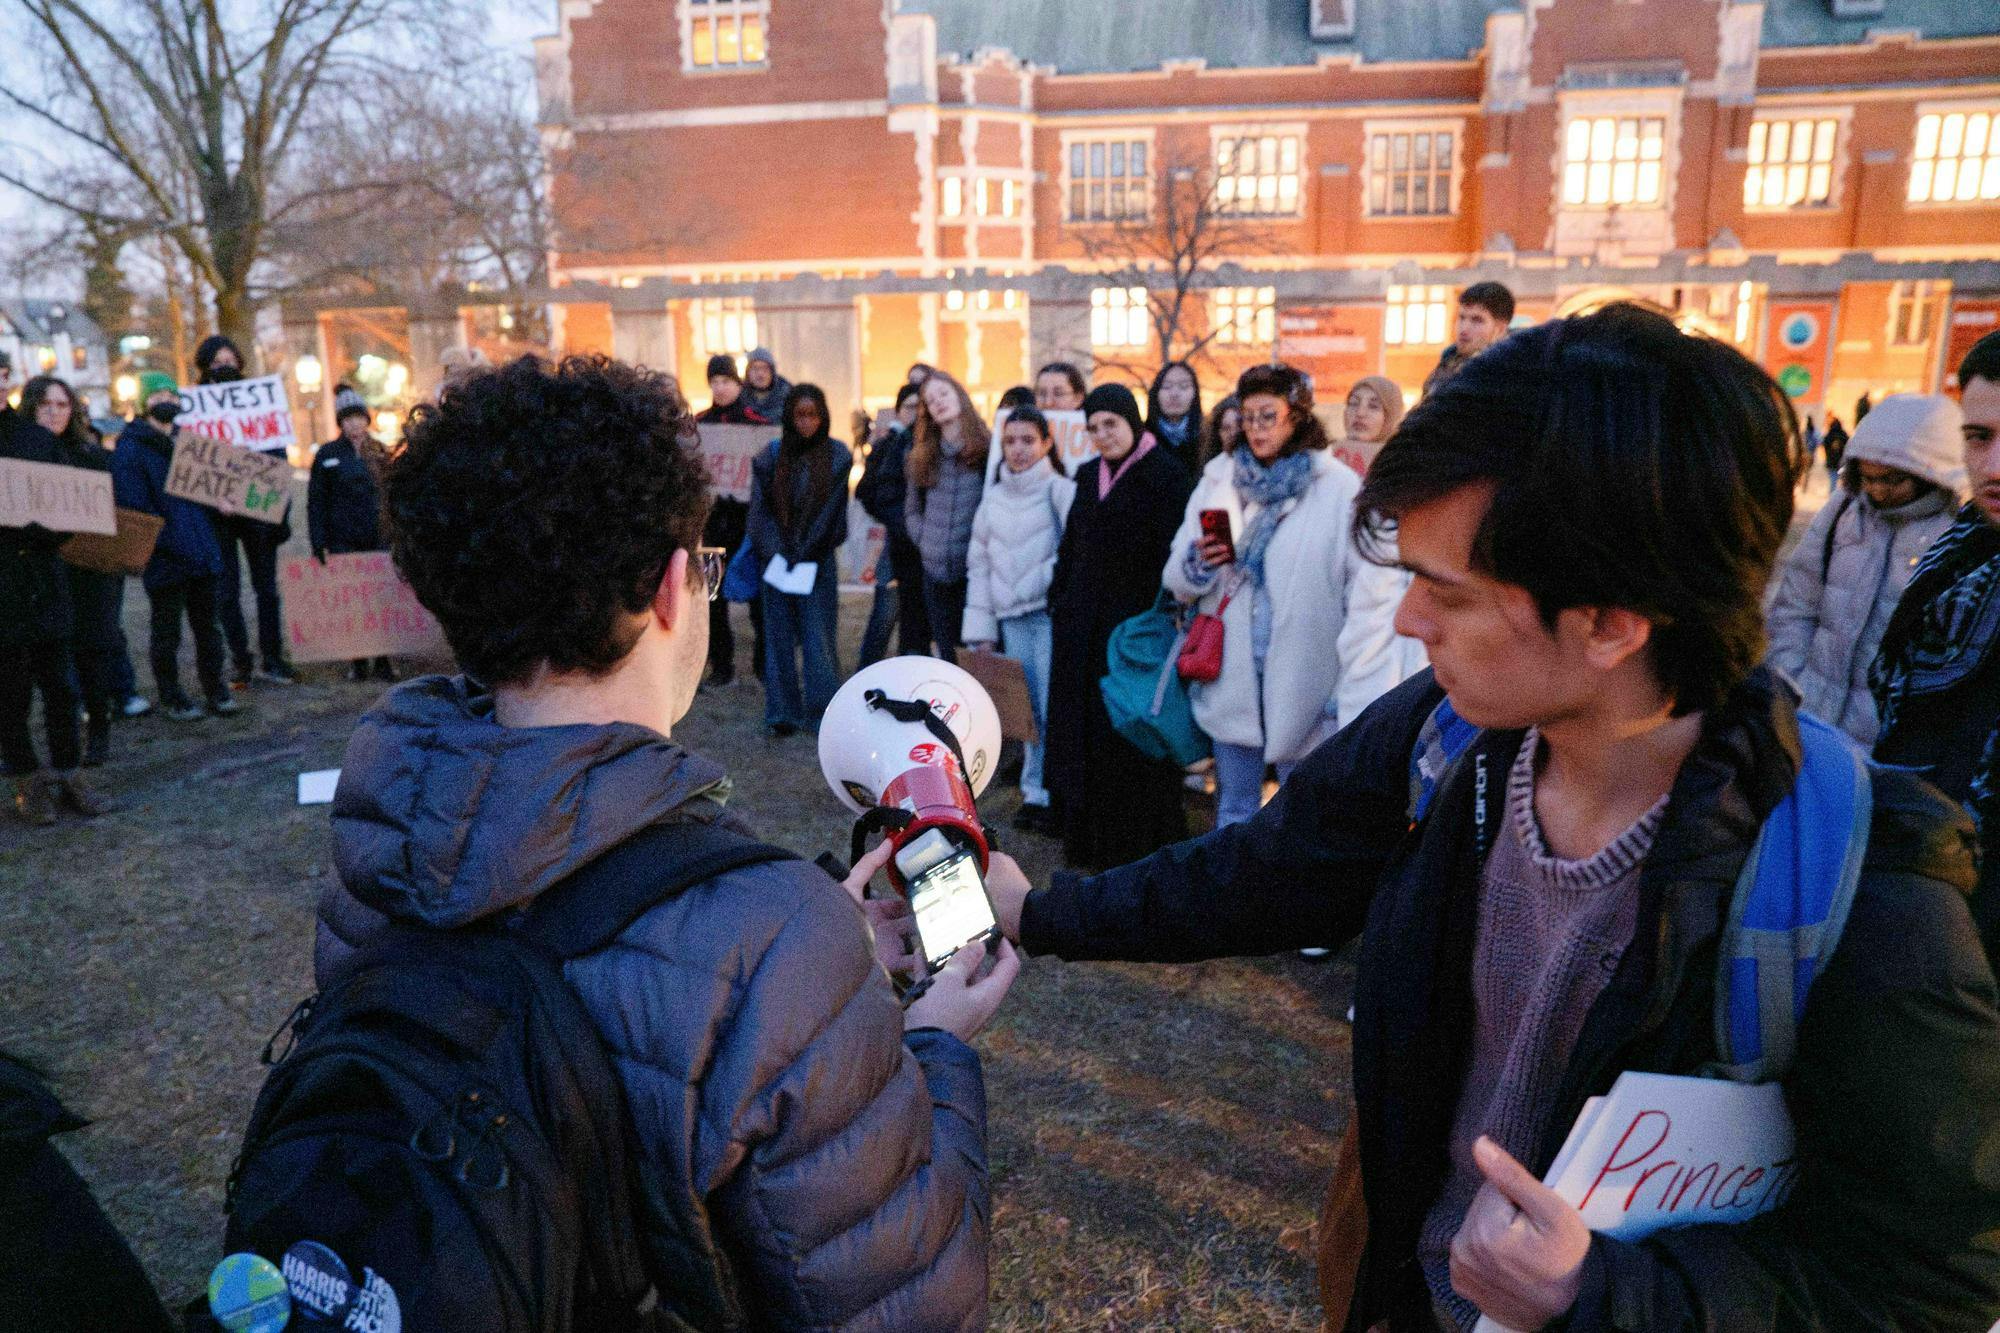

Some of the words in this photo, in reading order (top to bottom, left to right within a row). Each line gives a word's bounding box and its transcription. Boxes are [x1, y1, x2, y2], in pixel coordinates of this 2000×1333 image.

[181, 382, 275, 414] DIVEST
[170, 464, 241, 505] HATE
[282, 1252, 349, 1305] HARRIS
[290, 1282, 335, 1316] WALZ
